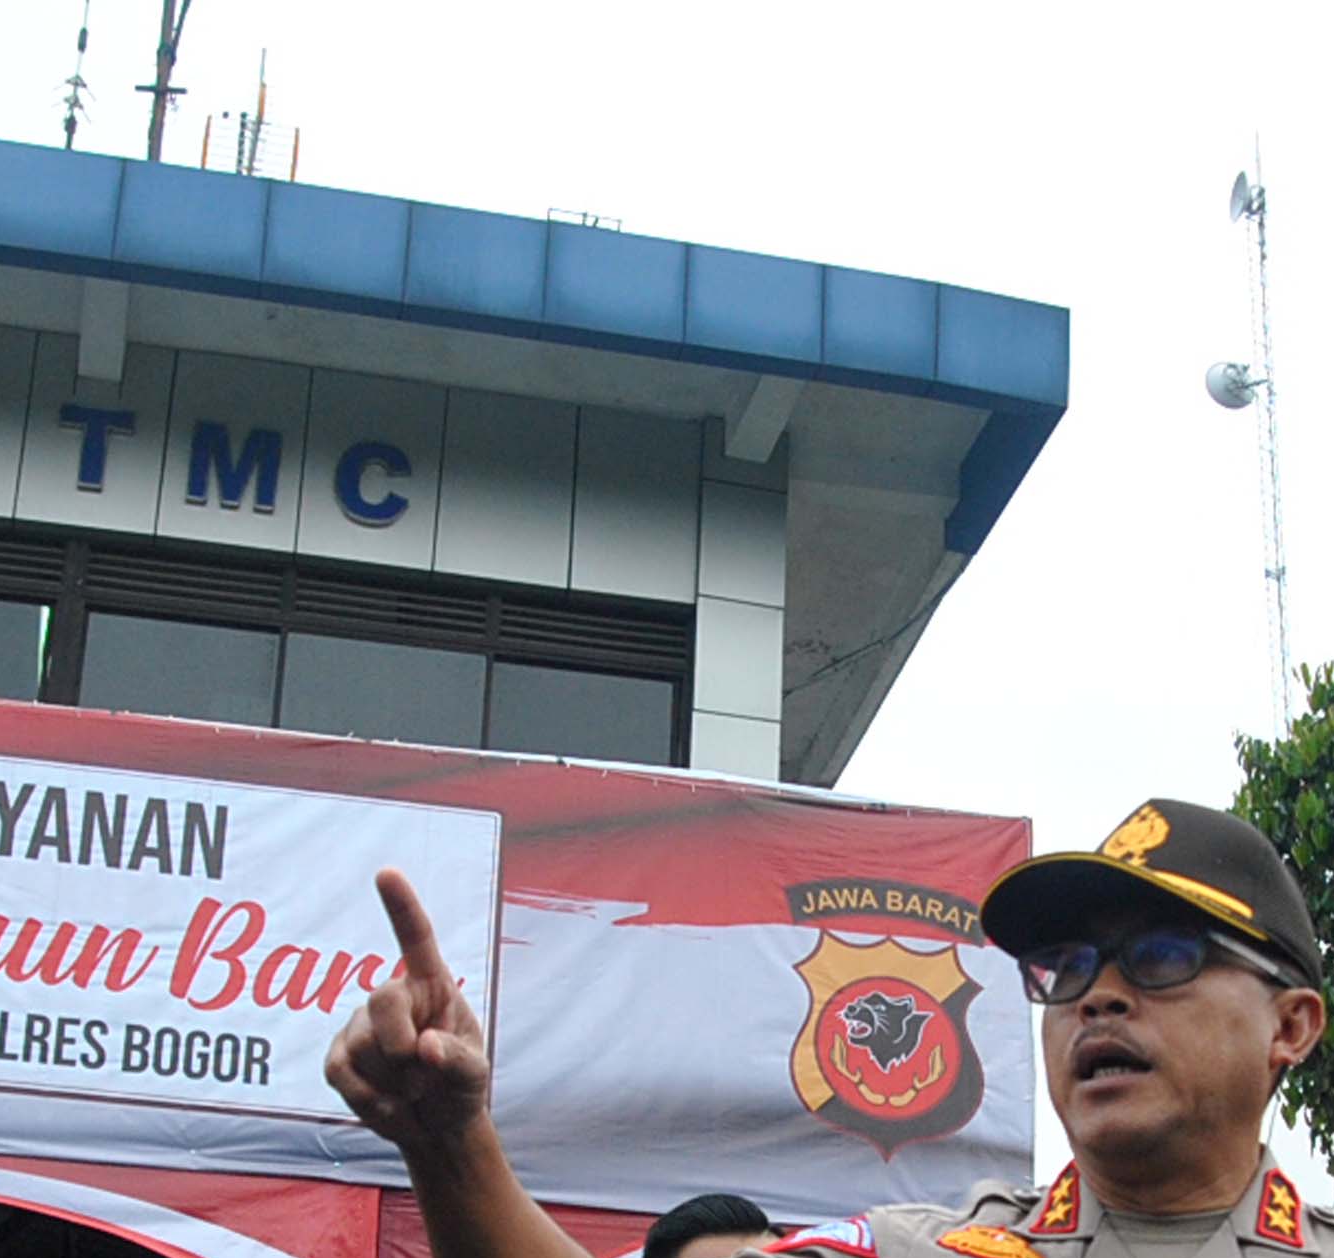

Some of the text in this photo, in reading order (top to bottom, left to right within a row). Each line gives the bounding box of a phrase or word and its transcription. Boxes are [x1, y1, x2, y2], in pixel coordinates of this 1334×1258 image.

[59, 402, 412, 529] TMC
[170, 896, 465, 1014] Bar
[802, 887, 979, 933] JAWA BARAT
[121, 1023, 271, 1085] BOGOR
